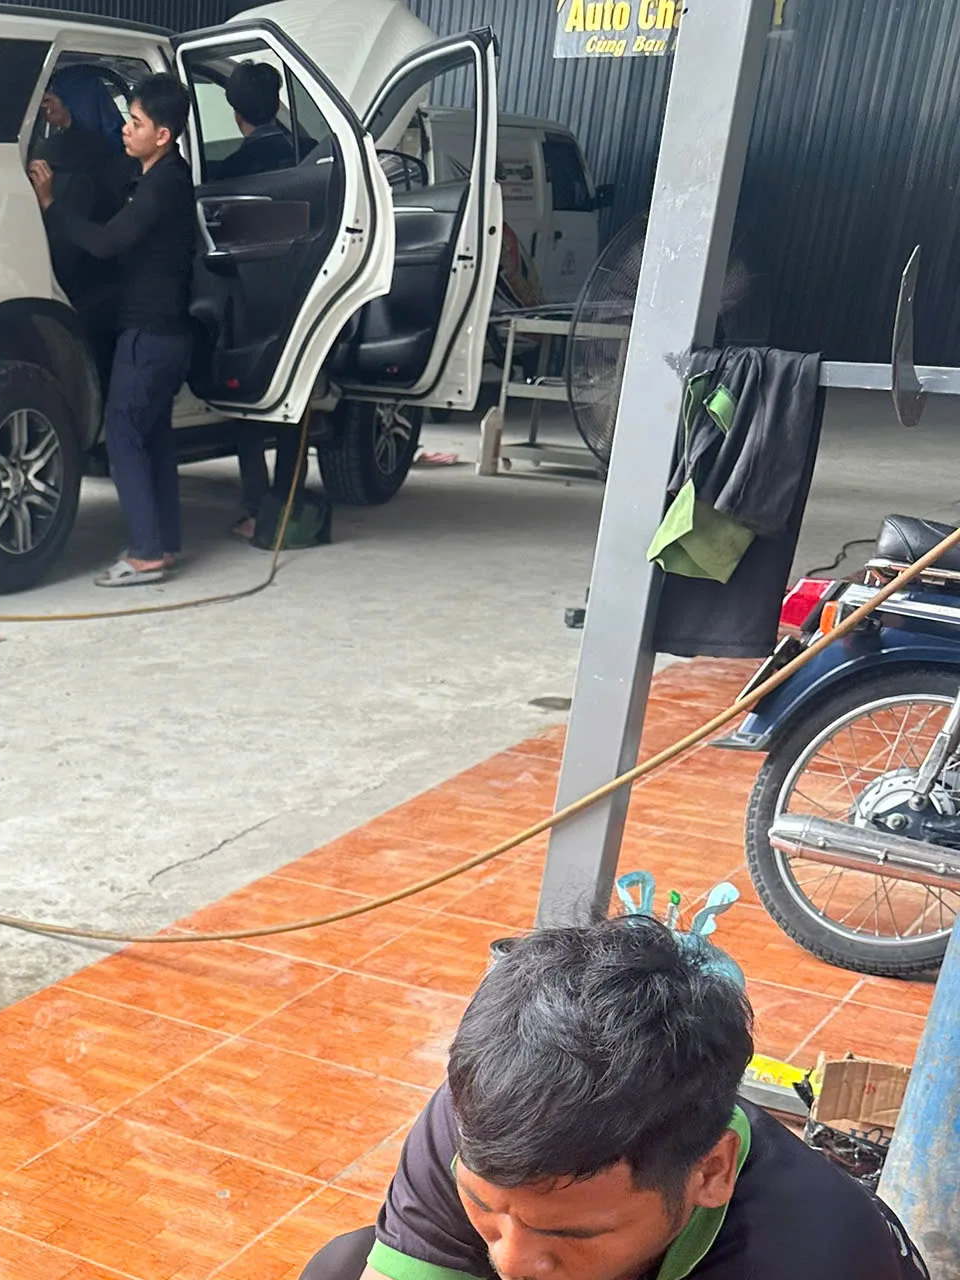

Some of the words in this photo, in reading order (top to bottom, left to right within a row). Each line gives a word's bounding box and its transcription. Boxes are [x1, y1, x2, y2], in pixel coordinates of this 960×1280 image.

[564, 0, 630, 32] Auto
[585, 36, 627, 57] Cùng
[632, 35, 666, 56] Bạn
